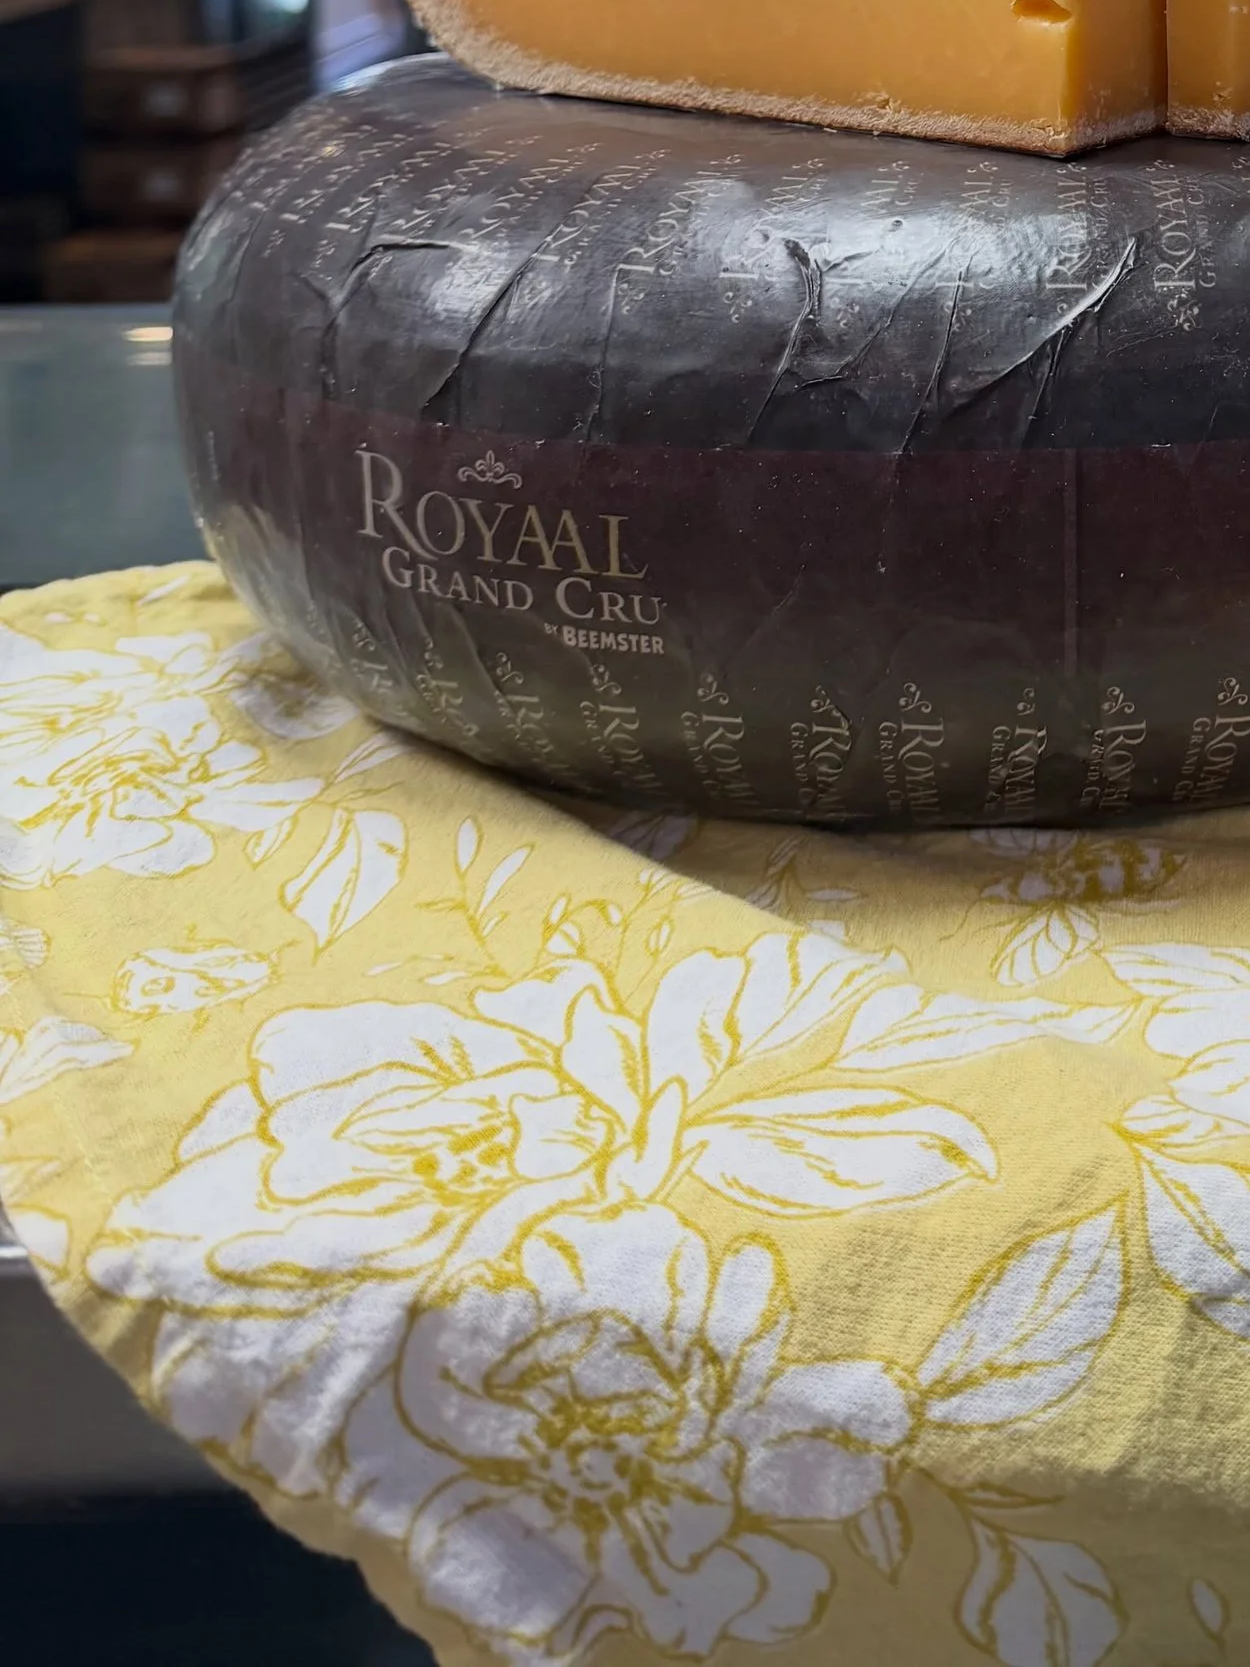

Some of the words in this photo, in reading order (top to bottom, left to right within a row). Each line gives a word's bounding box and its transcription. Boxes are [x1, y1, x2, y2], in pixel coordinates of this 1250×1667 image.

[1150, 176, 1197, 290] ROYAAL
[354, 449, 649, 579] ROYAAL
[381, 546, 534, 612] GRAND
[555, 576, 664, 625] CRU
[543, 622, 559, 636] BY
[562, 625, 665, 655] BEEMSTER
[878, 721, 898, 784] GRAND
[898, 717, 945, 812] ROYAAL
[987, 725, 1012, 785] GRAND
[1181, 716, 1212, 775] GRAND
